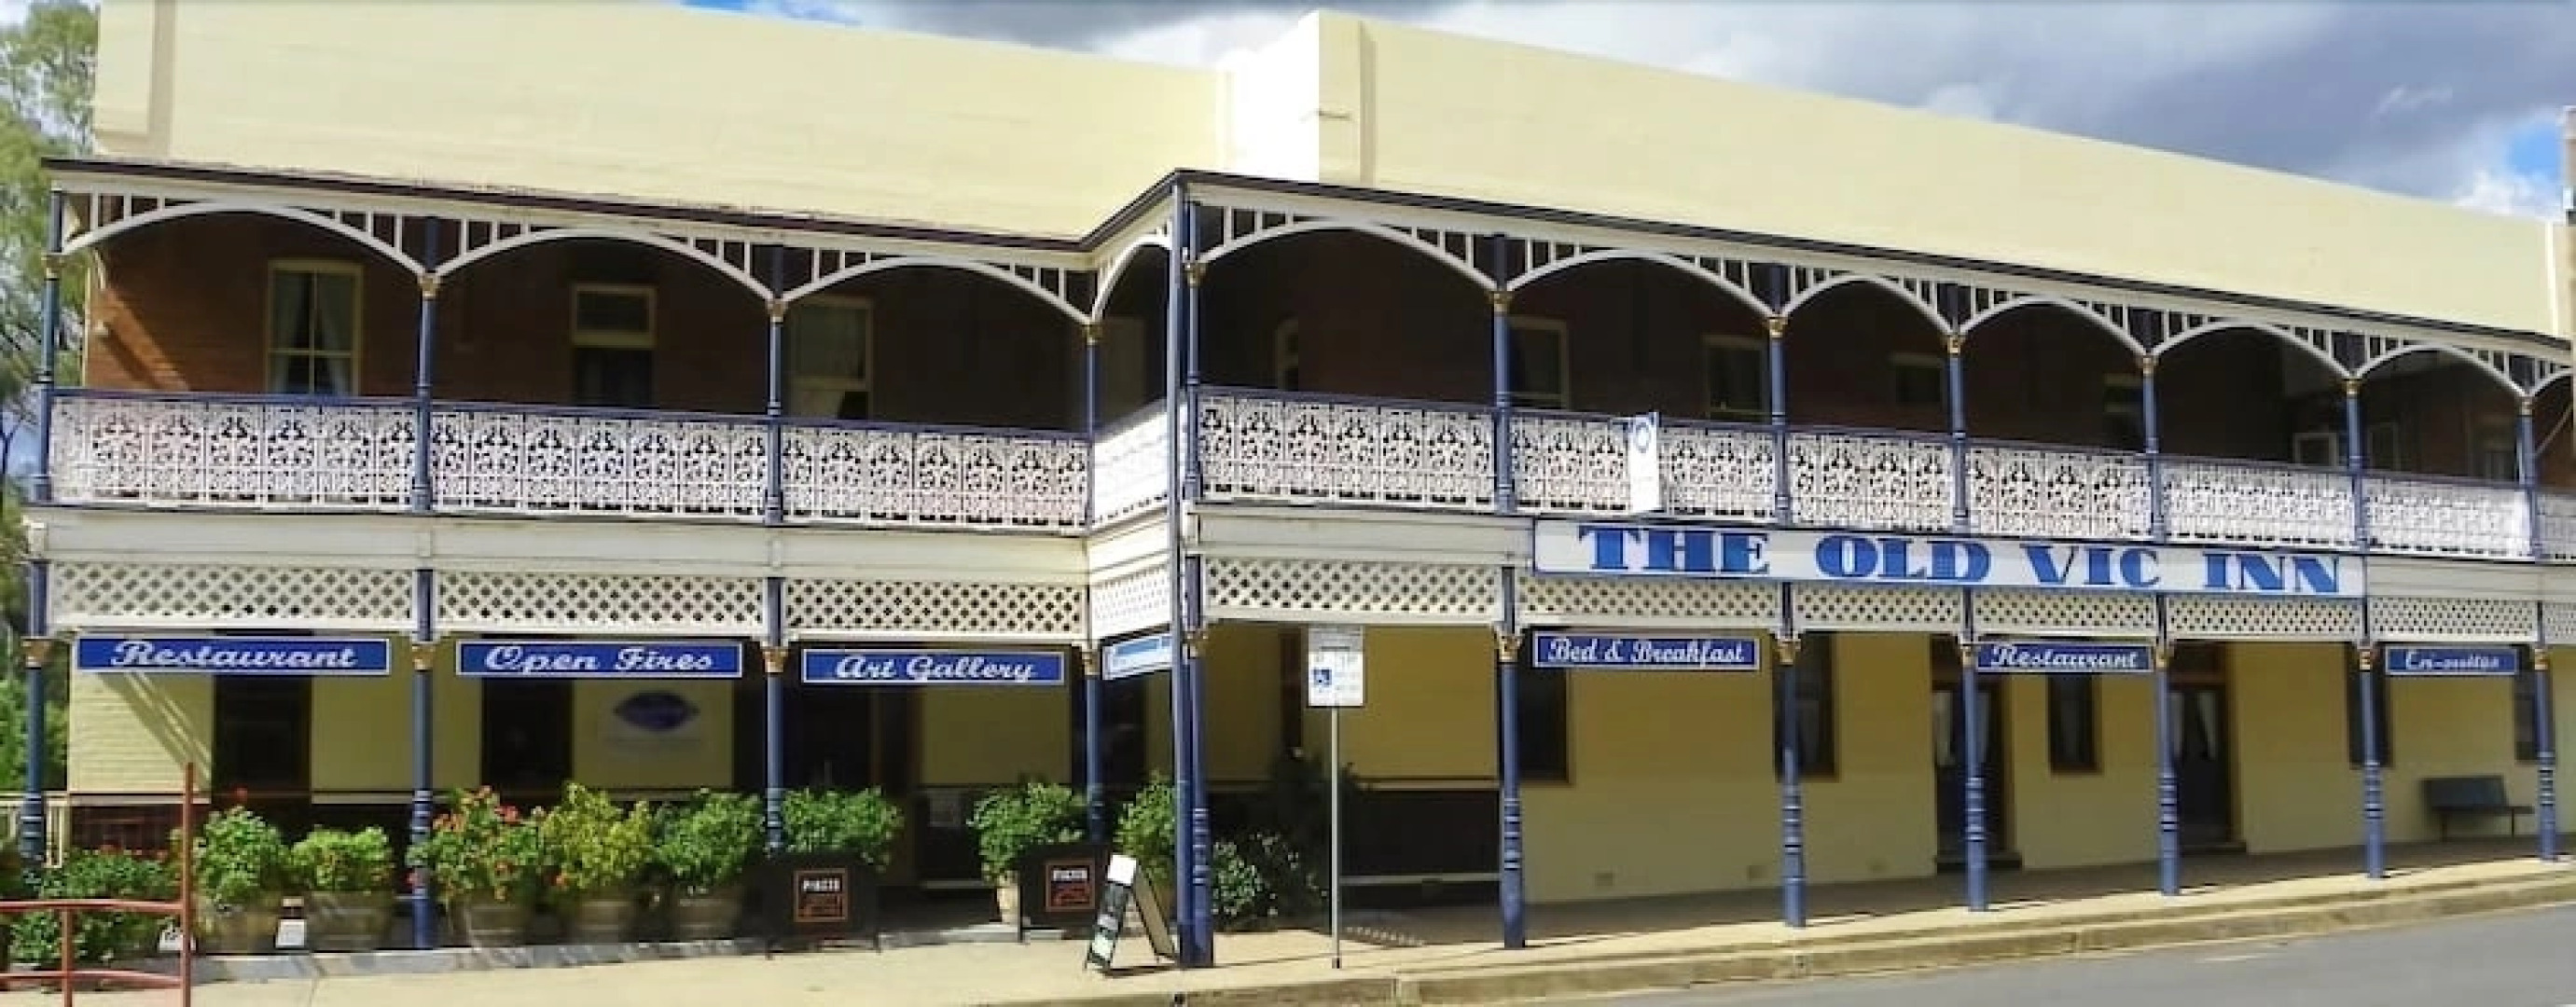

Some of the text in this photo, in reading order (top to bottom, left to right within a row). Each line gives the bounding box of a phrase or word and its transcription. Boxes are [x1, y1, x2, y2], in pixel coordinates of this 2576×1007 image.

[1579, 525, 2340, 593] THE OLD VIC INN
[110, 641, 359, 667] Restaurant
[484, 645, 713, 673] Open Fires
[1547, 638, 1745, 668] Bed & Breakfast
[1990, 643, 2140, 669] Restaurant
[837, 655, 1038, 683] Art Gallery
